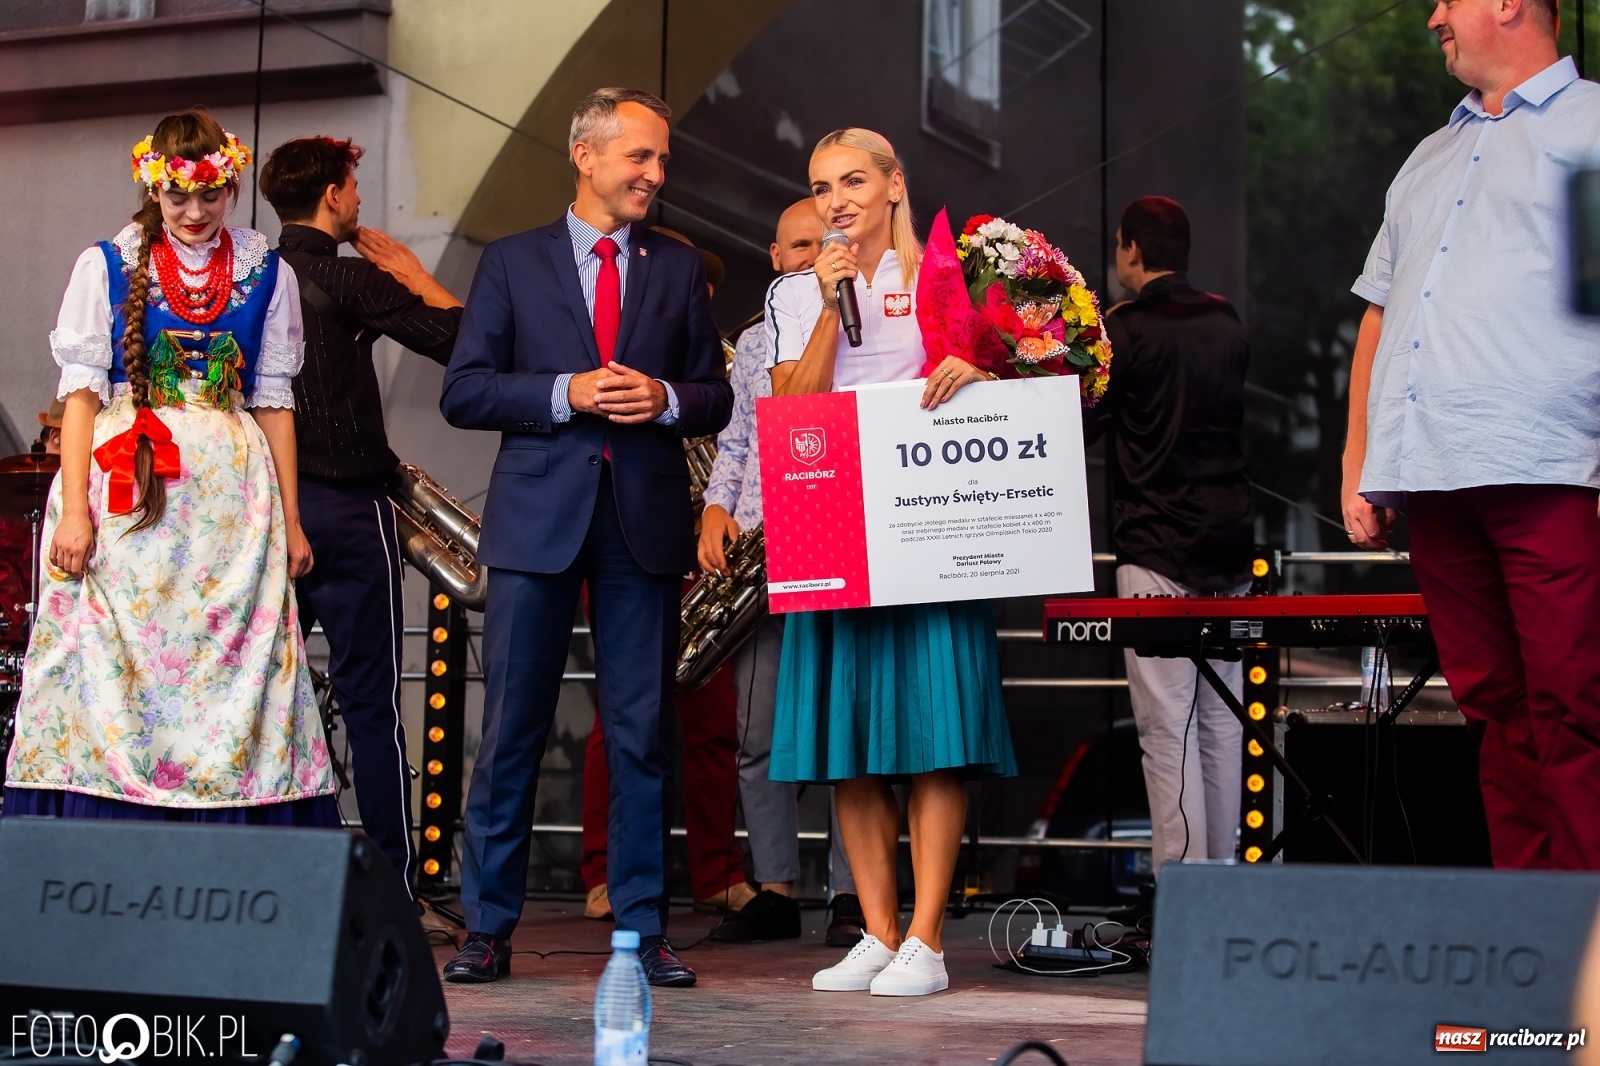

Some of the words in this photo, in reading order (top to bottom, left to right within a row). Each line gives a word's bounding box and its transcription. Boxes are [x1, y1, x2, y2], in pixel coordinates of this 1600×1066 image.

[933, 416, 964, 426] Miasto
[967, 413, 1008, 424] Racibórz
[896, 442, 932, 468] 10
[942, 436, 1008, 464] 000
[1018, 432, 1047, 460] zł
[784, 468, 836, 480] RACIBÓRZ
[894, 493, 950, 508] Justyny
[952, 485, 1054, 504] Święty-Ersetic
[985, 529, 1020, 537] Olimpijskich
[939, 571, 969, 579] Racibórz,
[979, 569, 1005, 578] sierpnia
[782, 581, 831, 590] www.raciborz.pl
[1057, 618, 1112, 642] nord
[38, 879, 280, 925] POL-AUDIO
[1222, 936, 1546, 989] POL-AUDIO
